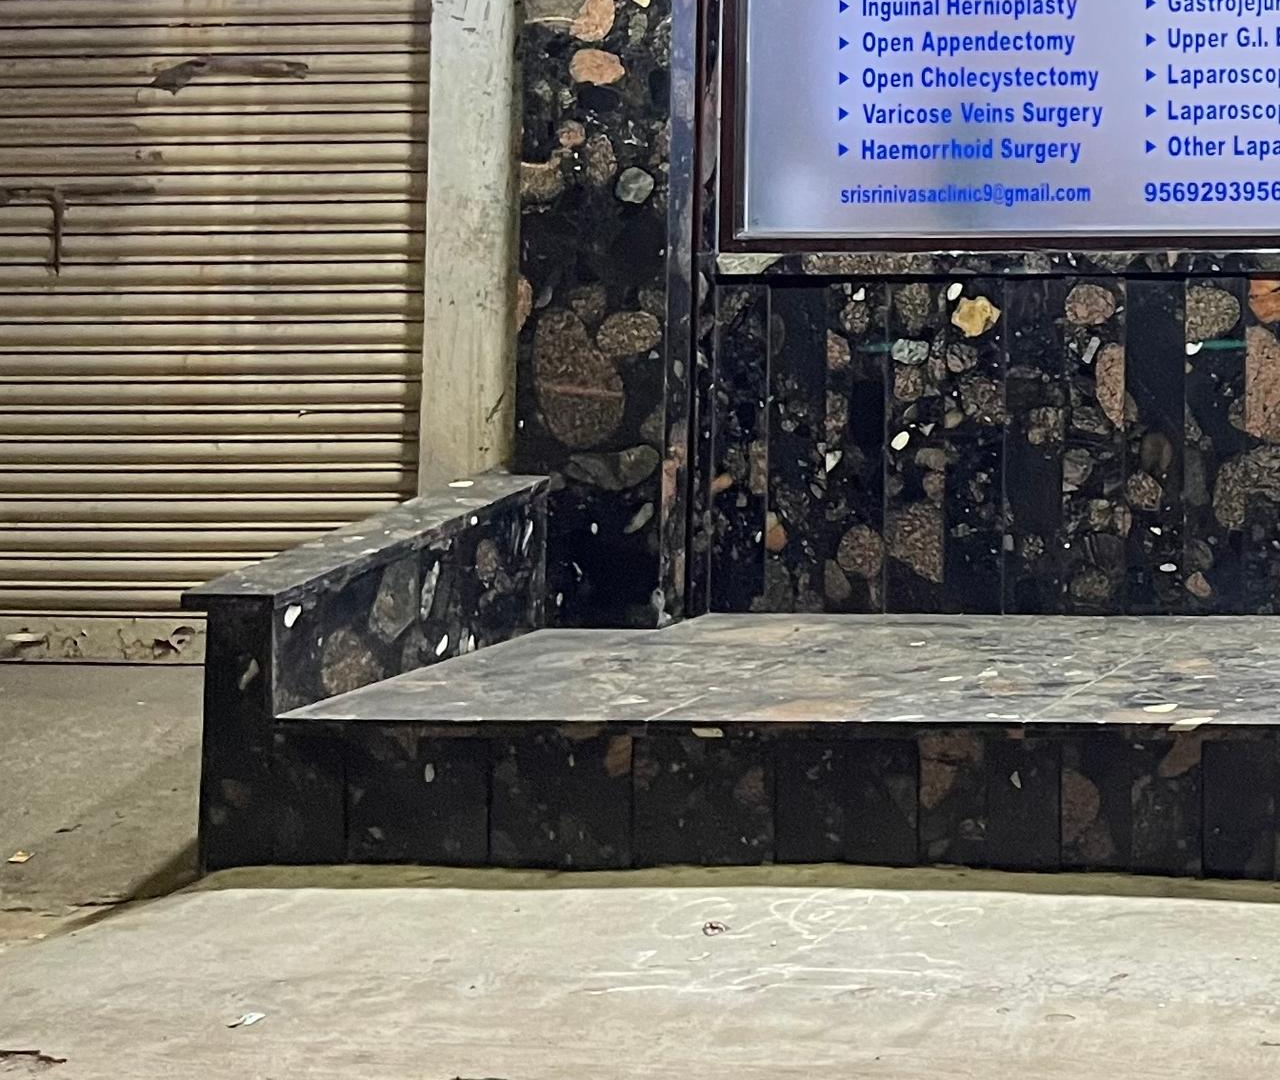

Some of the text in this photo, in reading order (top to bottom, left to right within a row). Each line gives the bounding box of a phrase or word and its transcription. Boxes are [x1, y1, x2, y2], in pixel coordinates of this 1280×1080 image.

[863, 31, 1075, 57] Open Appendectomy
[1168, 28, 1228, 53] Upper
[1237, 27, 1268, 47] G.I.
[863, 67, 1098, 93] Open Cholecystectomy
[863, 102, 1102, 127] Varicose Veins Surgery
[862, 138, 1081, 163] Haemorrhoid Surgery
[1168, 136, 1225, 156] Other
